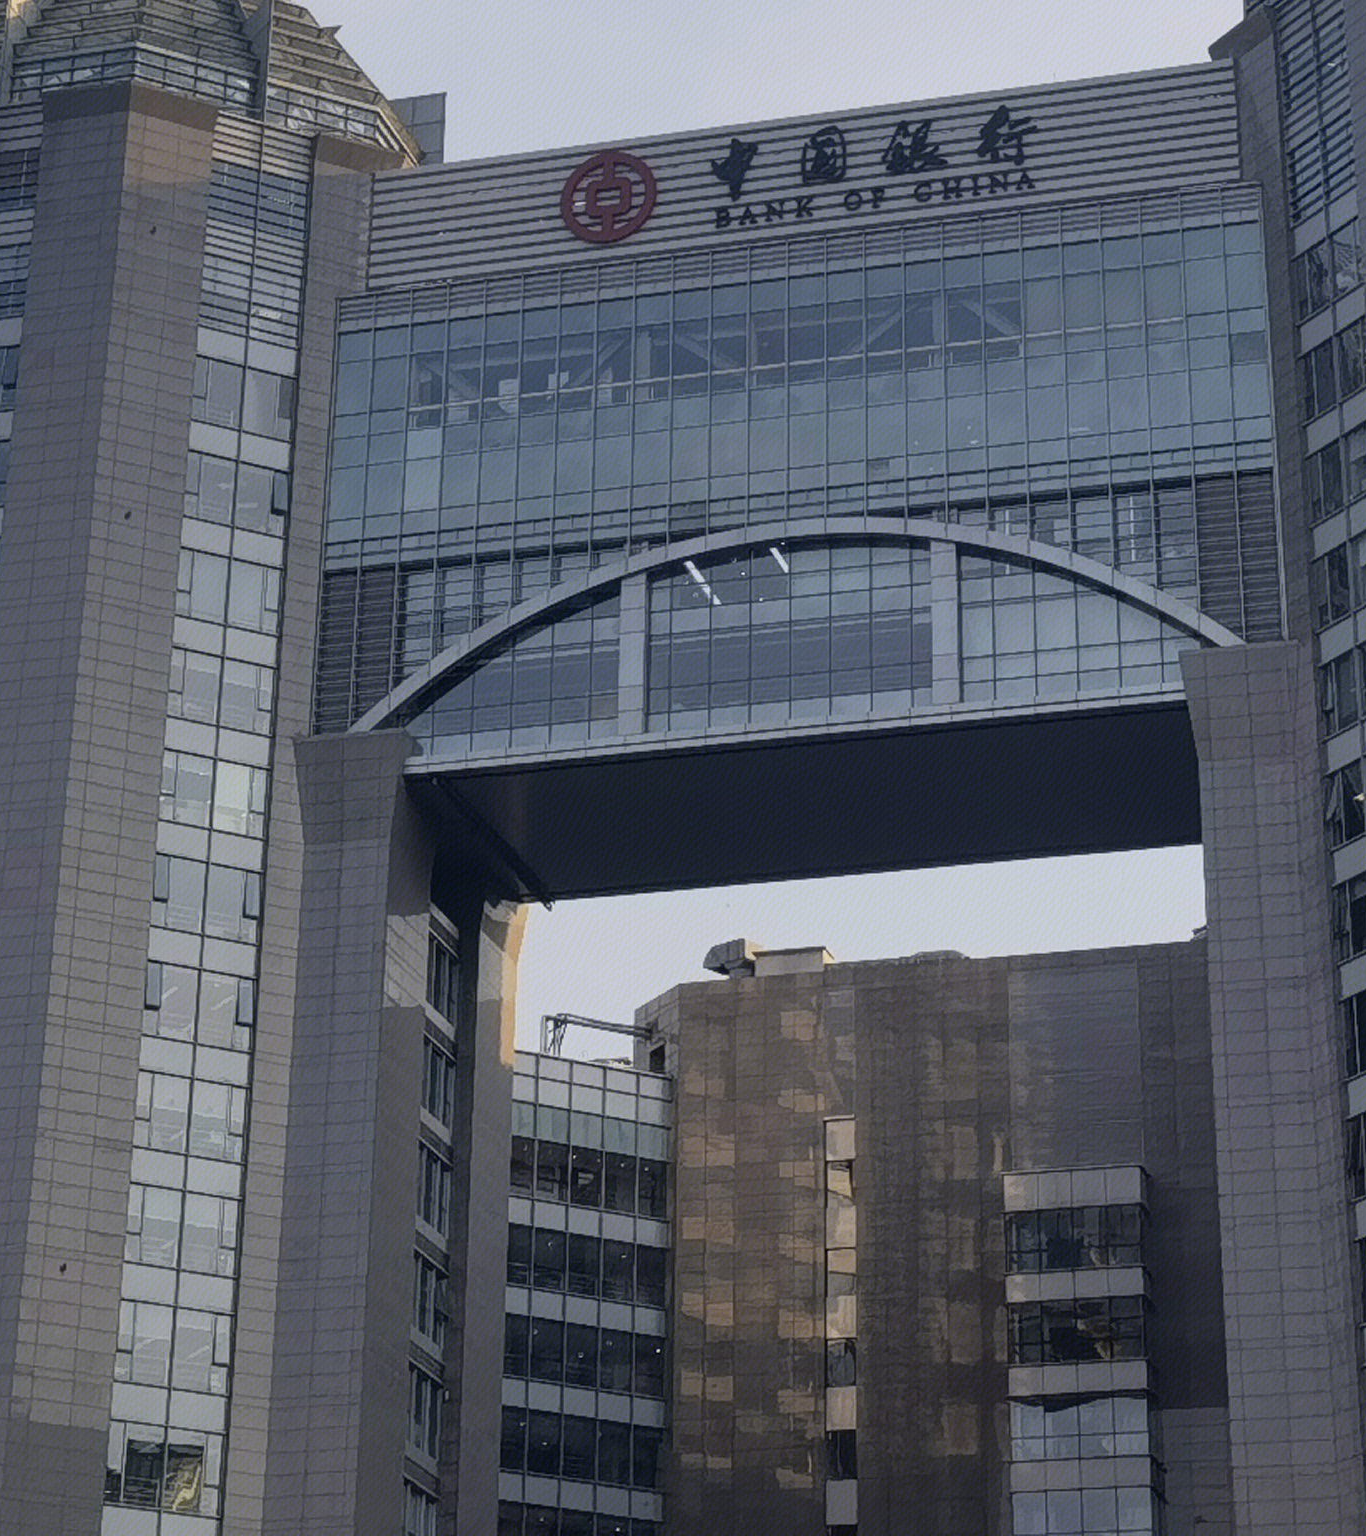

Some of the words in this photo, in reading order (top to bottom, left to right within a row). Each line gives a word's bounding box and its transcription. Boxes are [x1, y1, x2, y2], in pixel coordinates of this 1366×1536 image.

[711, 104, 1038, 202] 中国银行
[715, 195, 815, 229] BANK
[843, 188, 887, 212] OF
[914, 171, 1036, 203] CHINA
